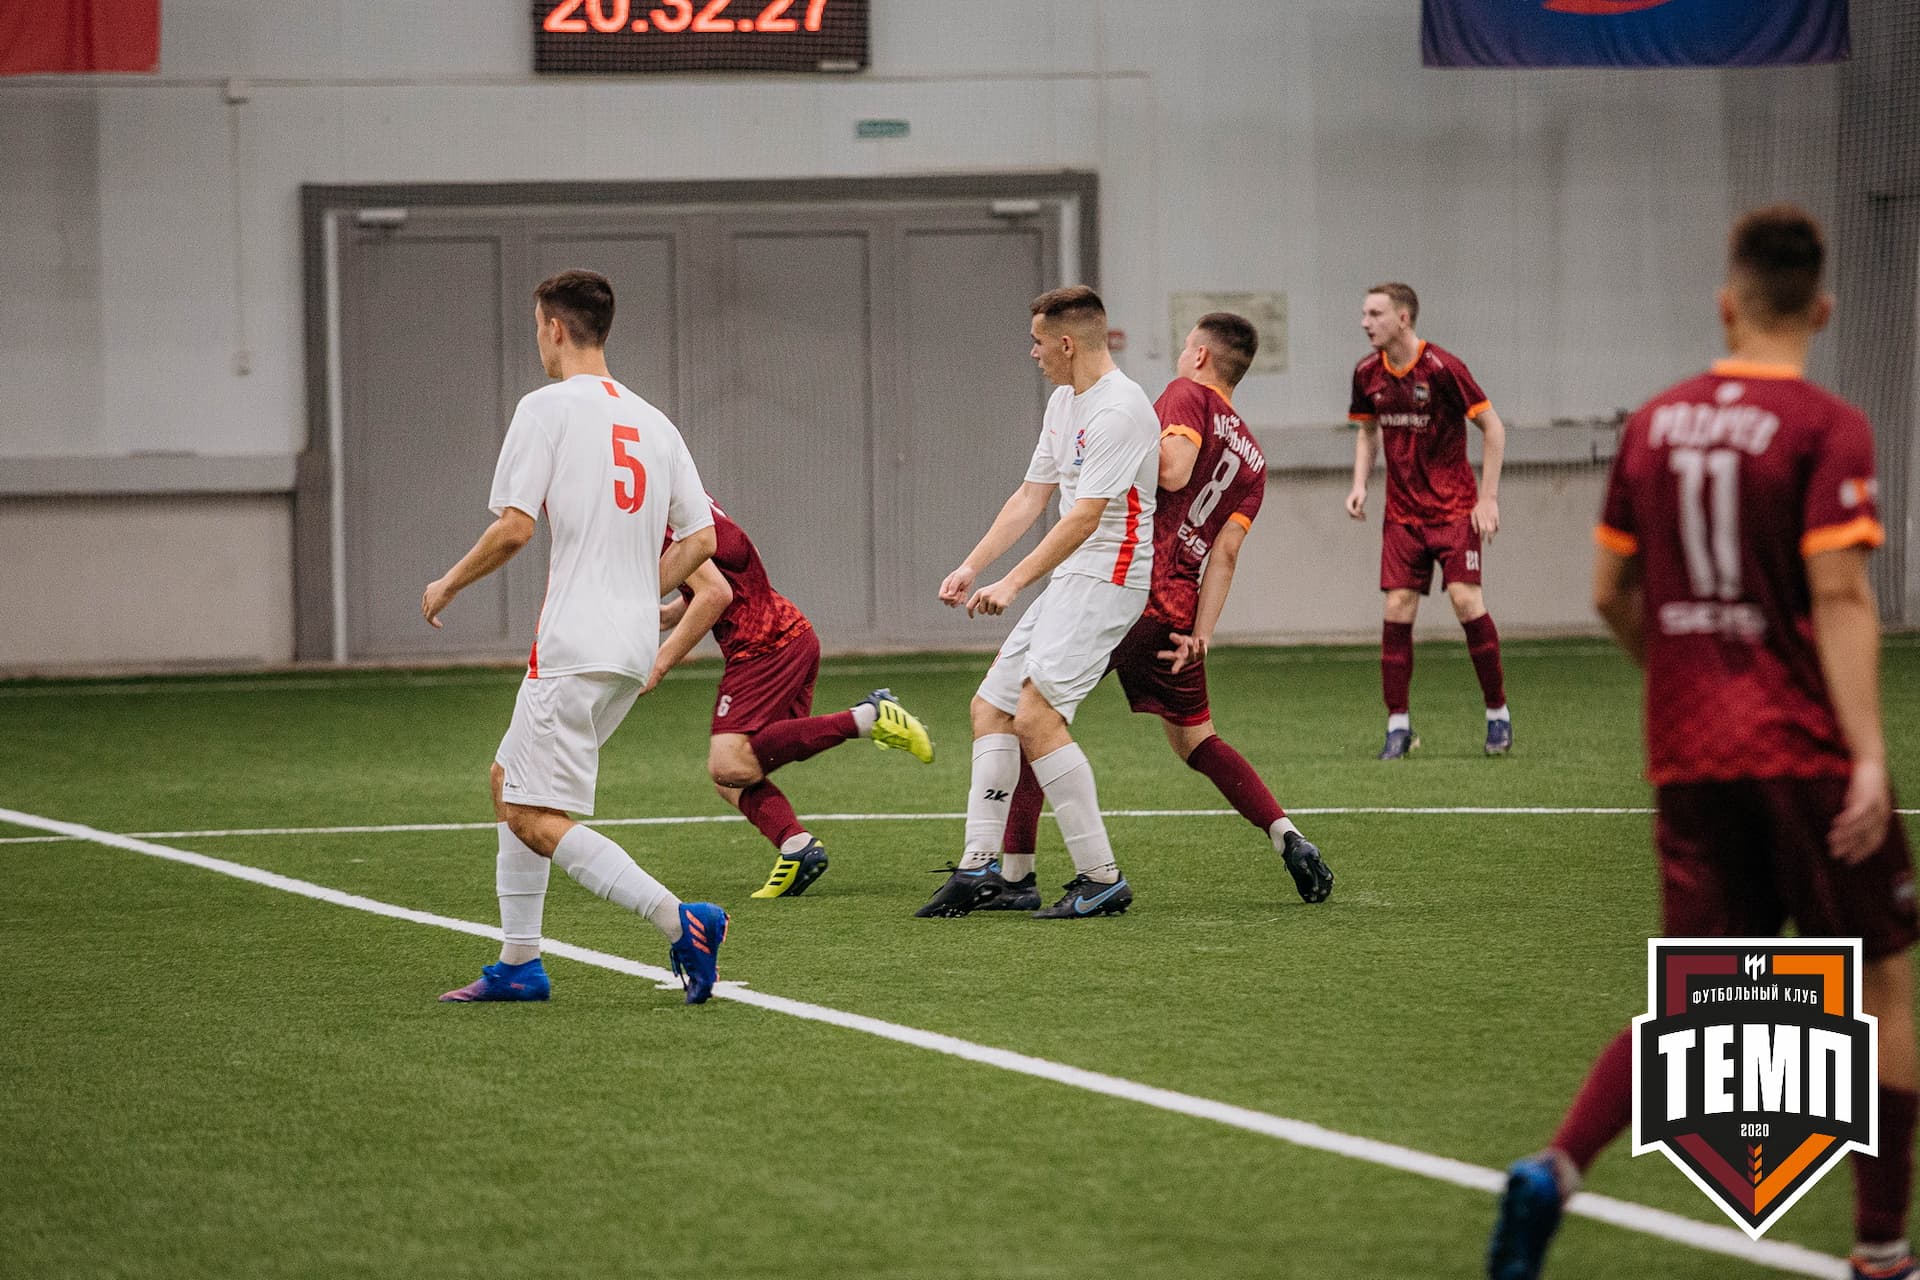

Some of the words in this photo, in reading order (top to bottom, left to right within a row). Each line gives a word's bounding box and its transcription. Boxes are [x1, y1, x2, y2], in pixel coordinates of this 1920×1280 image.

[611, 423, 647, 514] 5
[1188, 448, 1241, 528] 8
[1668, 448, 1740, 600] 11
[717, 694, 733, 717] 6
[984, 788, 1009, 803] 2K
